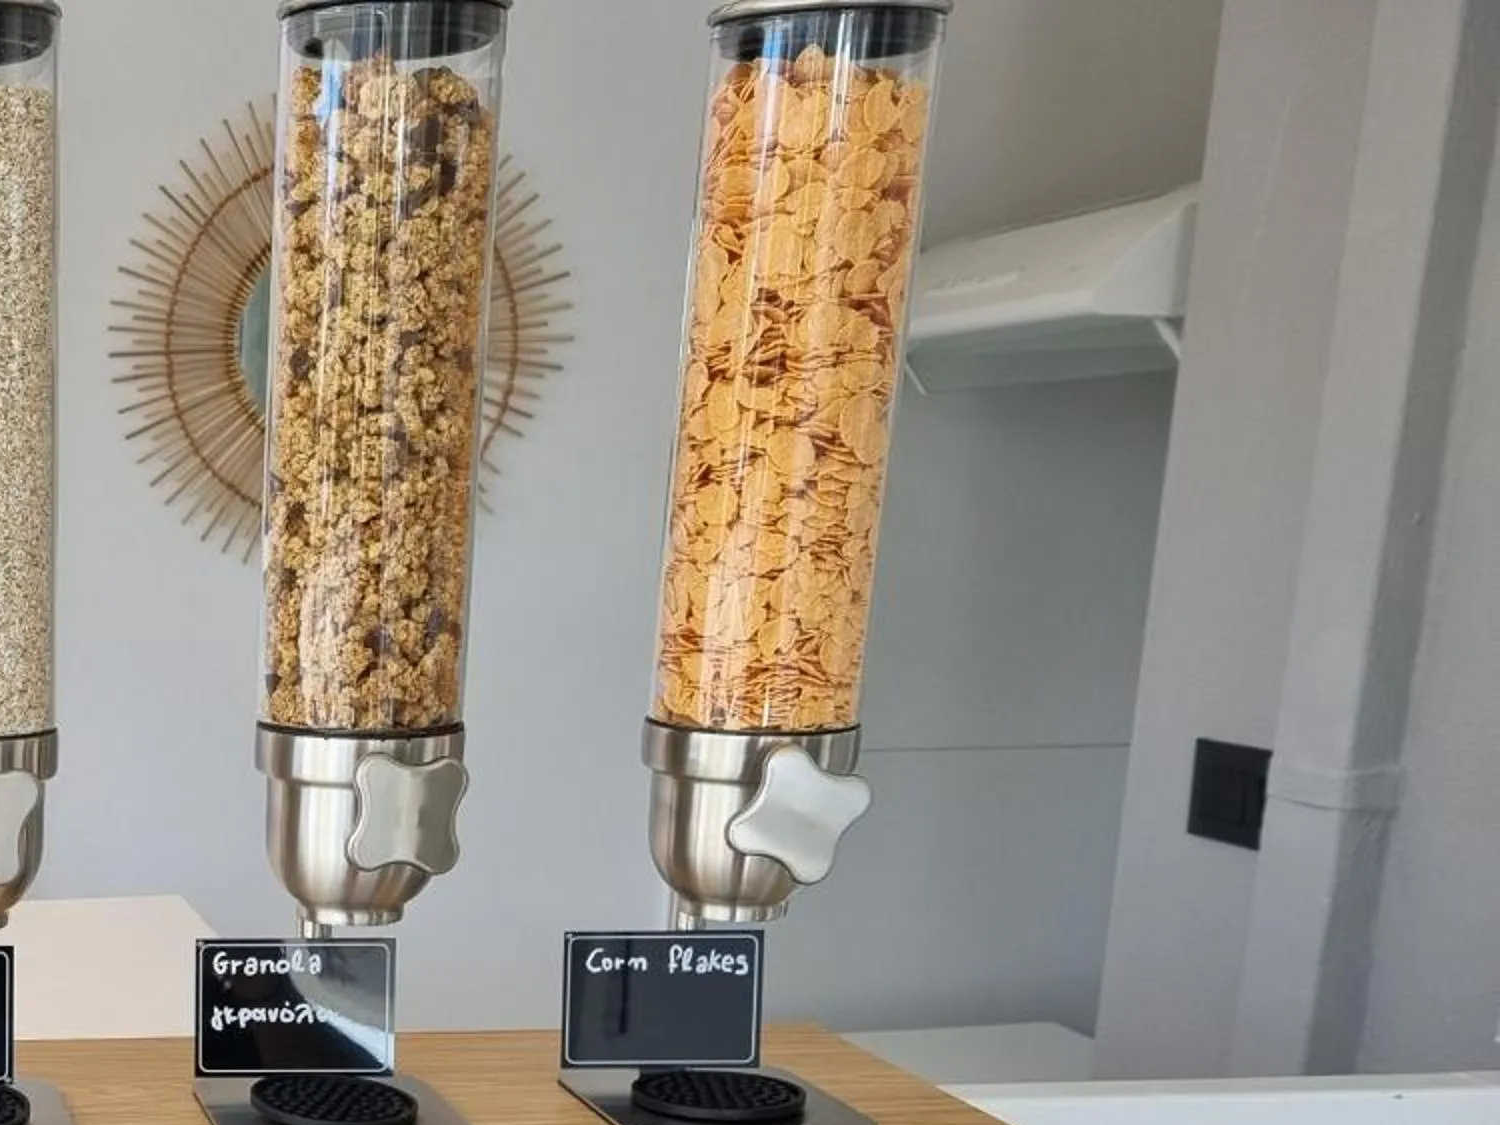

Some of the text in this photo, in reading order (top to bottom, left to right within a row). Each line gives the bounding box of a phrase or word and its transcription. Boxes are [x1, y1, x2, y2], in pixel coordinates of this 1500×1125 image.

[213, 951, 323, 976] Granola
[585, 943, 749, 976] Corn flakes
